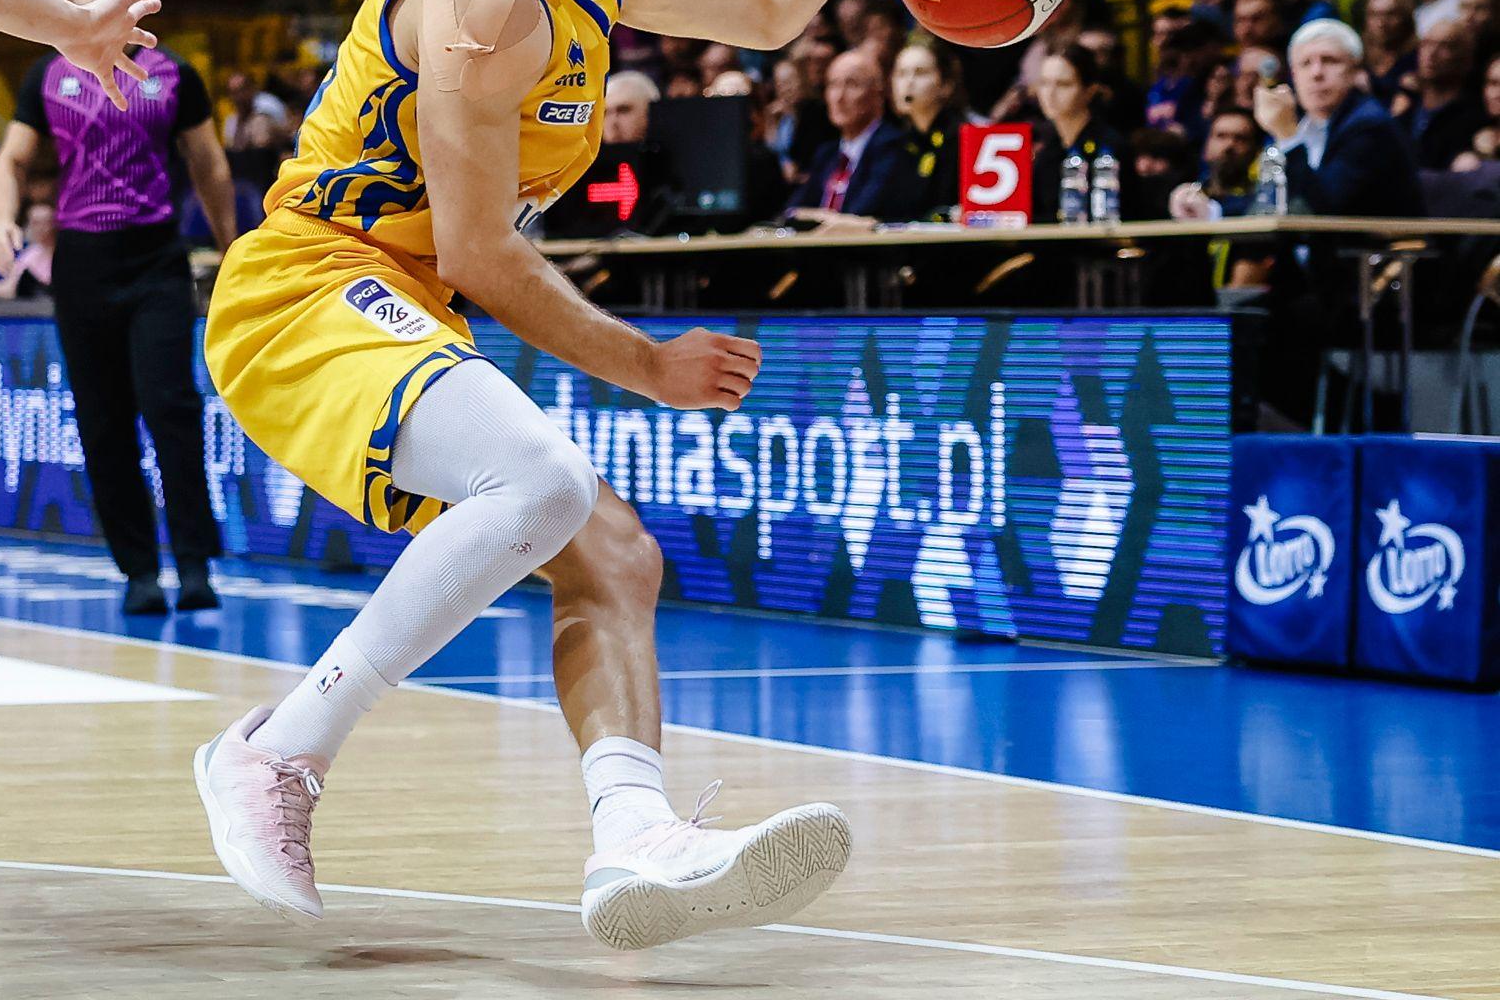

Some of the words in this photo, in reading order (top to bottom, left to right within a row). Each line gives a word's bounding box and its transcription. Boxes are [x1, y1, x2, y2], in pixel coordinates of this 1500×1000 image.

[545, 106, 574, 121] PGE
[966, 132, 1024, 206] 5
[352, 283, 380, 305] PGE
